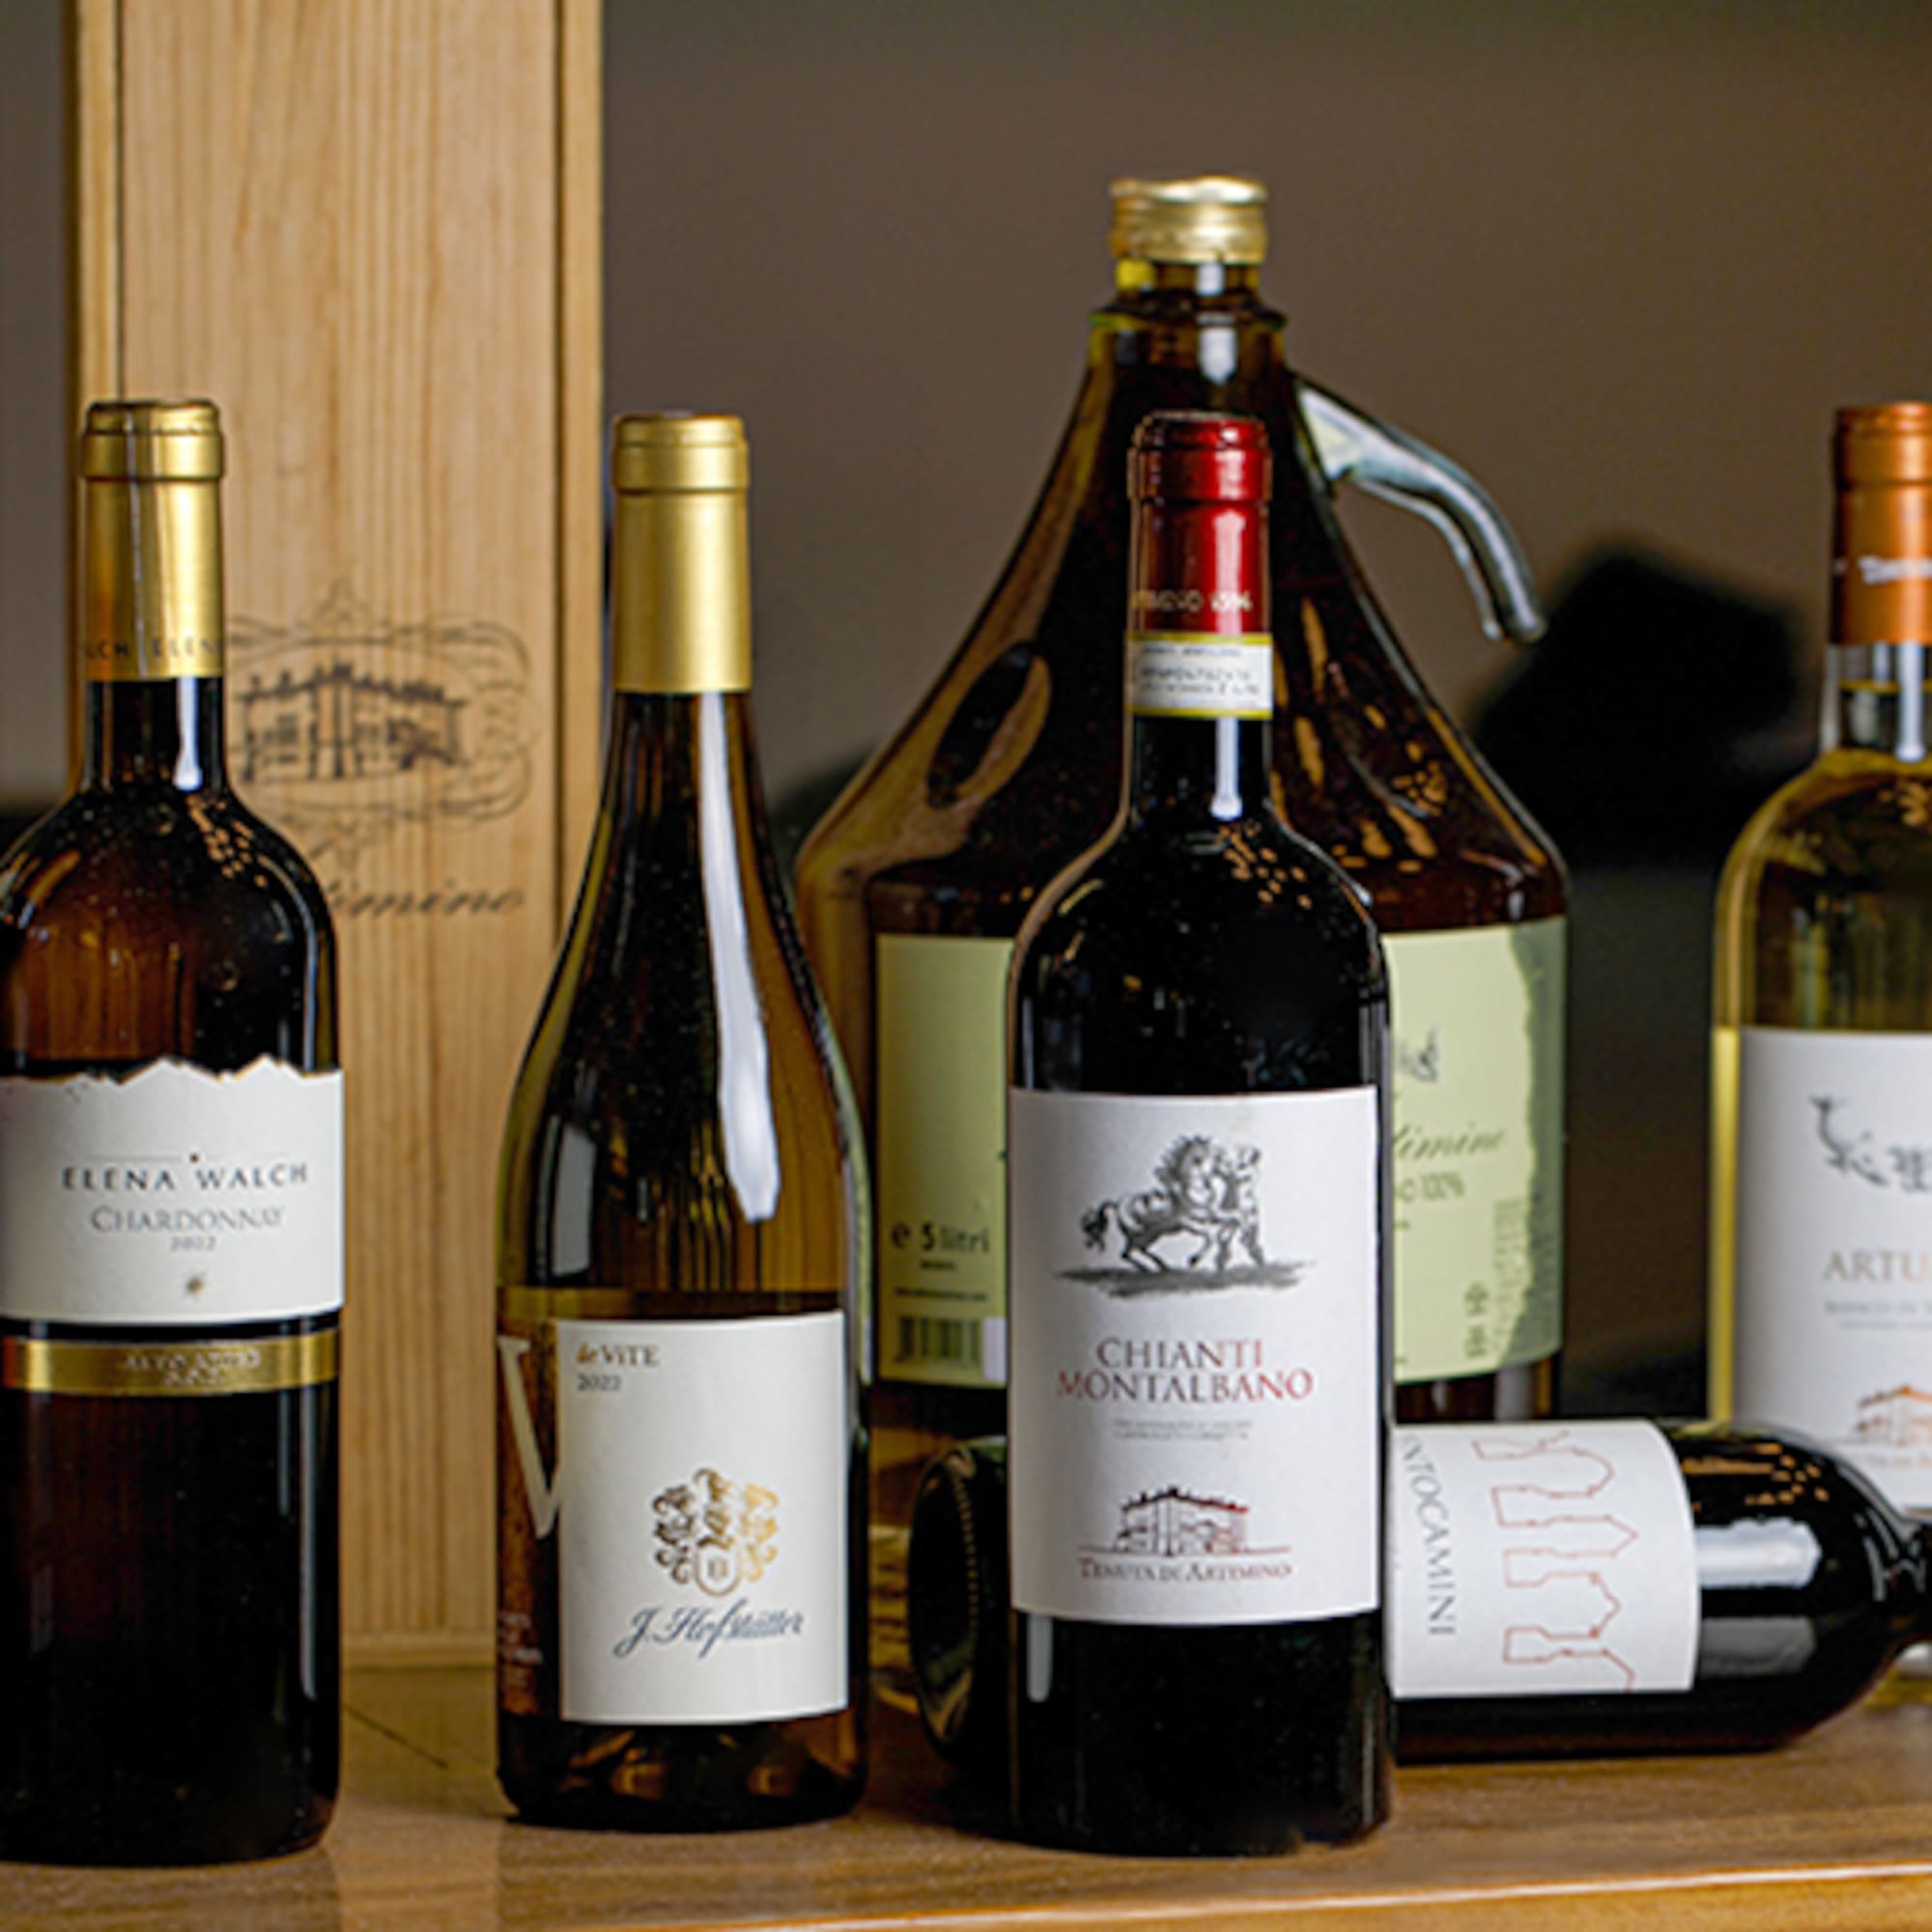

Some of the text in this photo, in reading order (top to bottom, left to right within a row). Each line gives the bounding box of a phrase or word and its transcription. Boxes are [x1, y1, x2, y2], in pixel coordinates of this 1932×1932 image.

[62, 1163, 308, 1190] ELENA WALCH
[1096, 1335, 1264, 1369] CHIANTI
[1058, 1369, 1315, 1402] MONTALBANO
